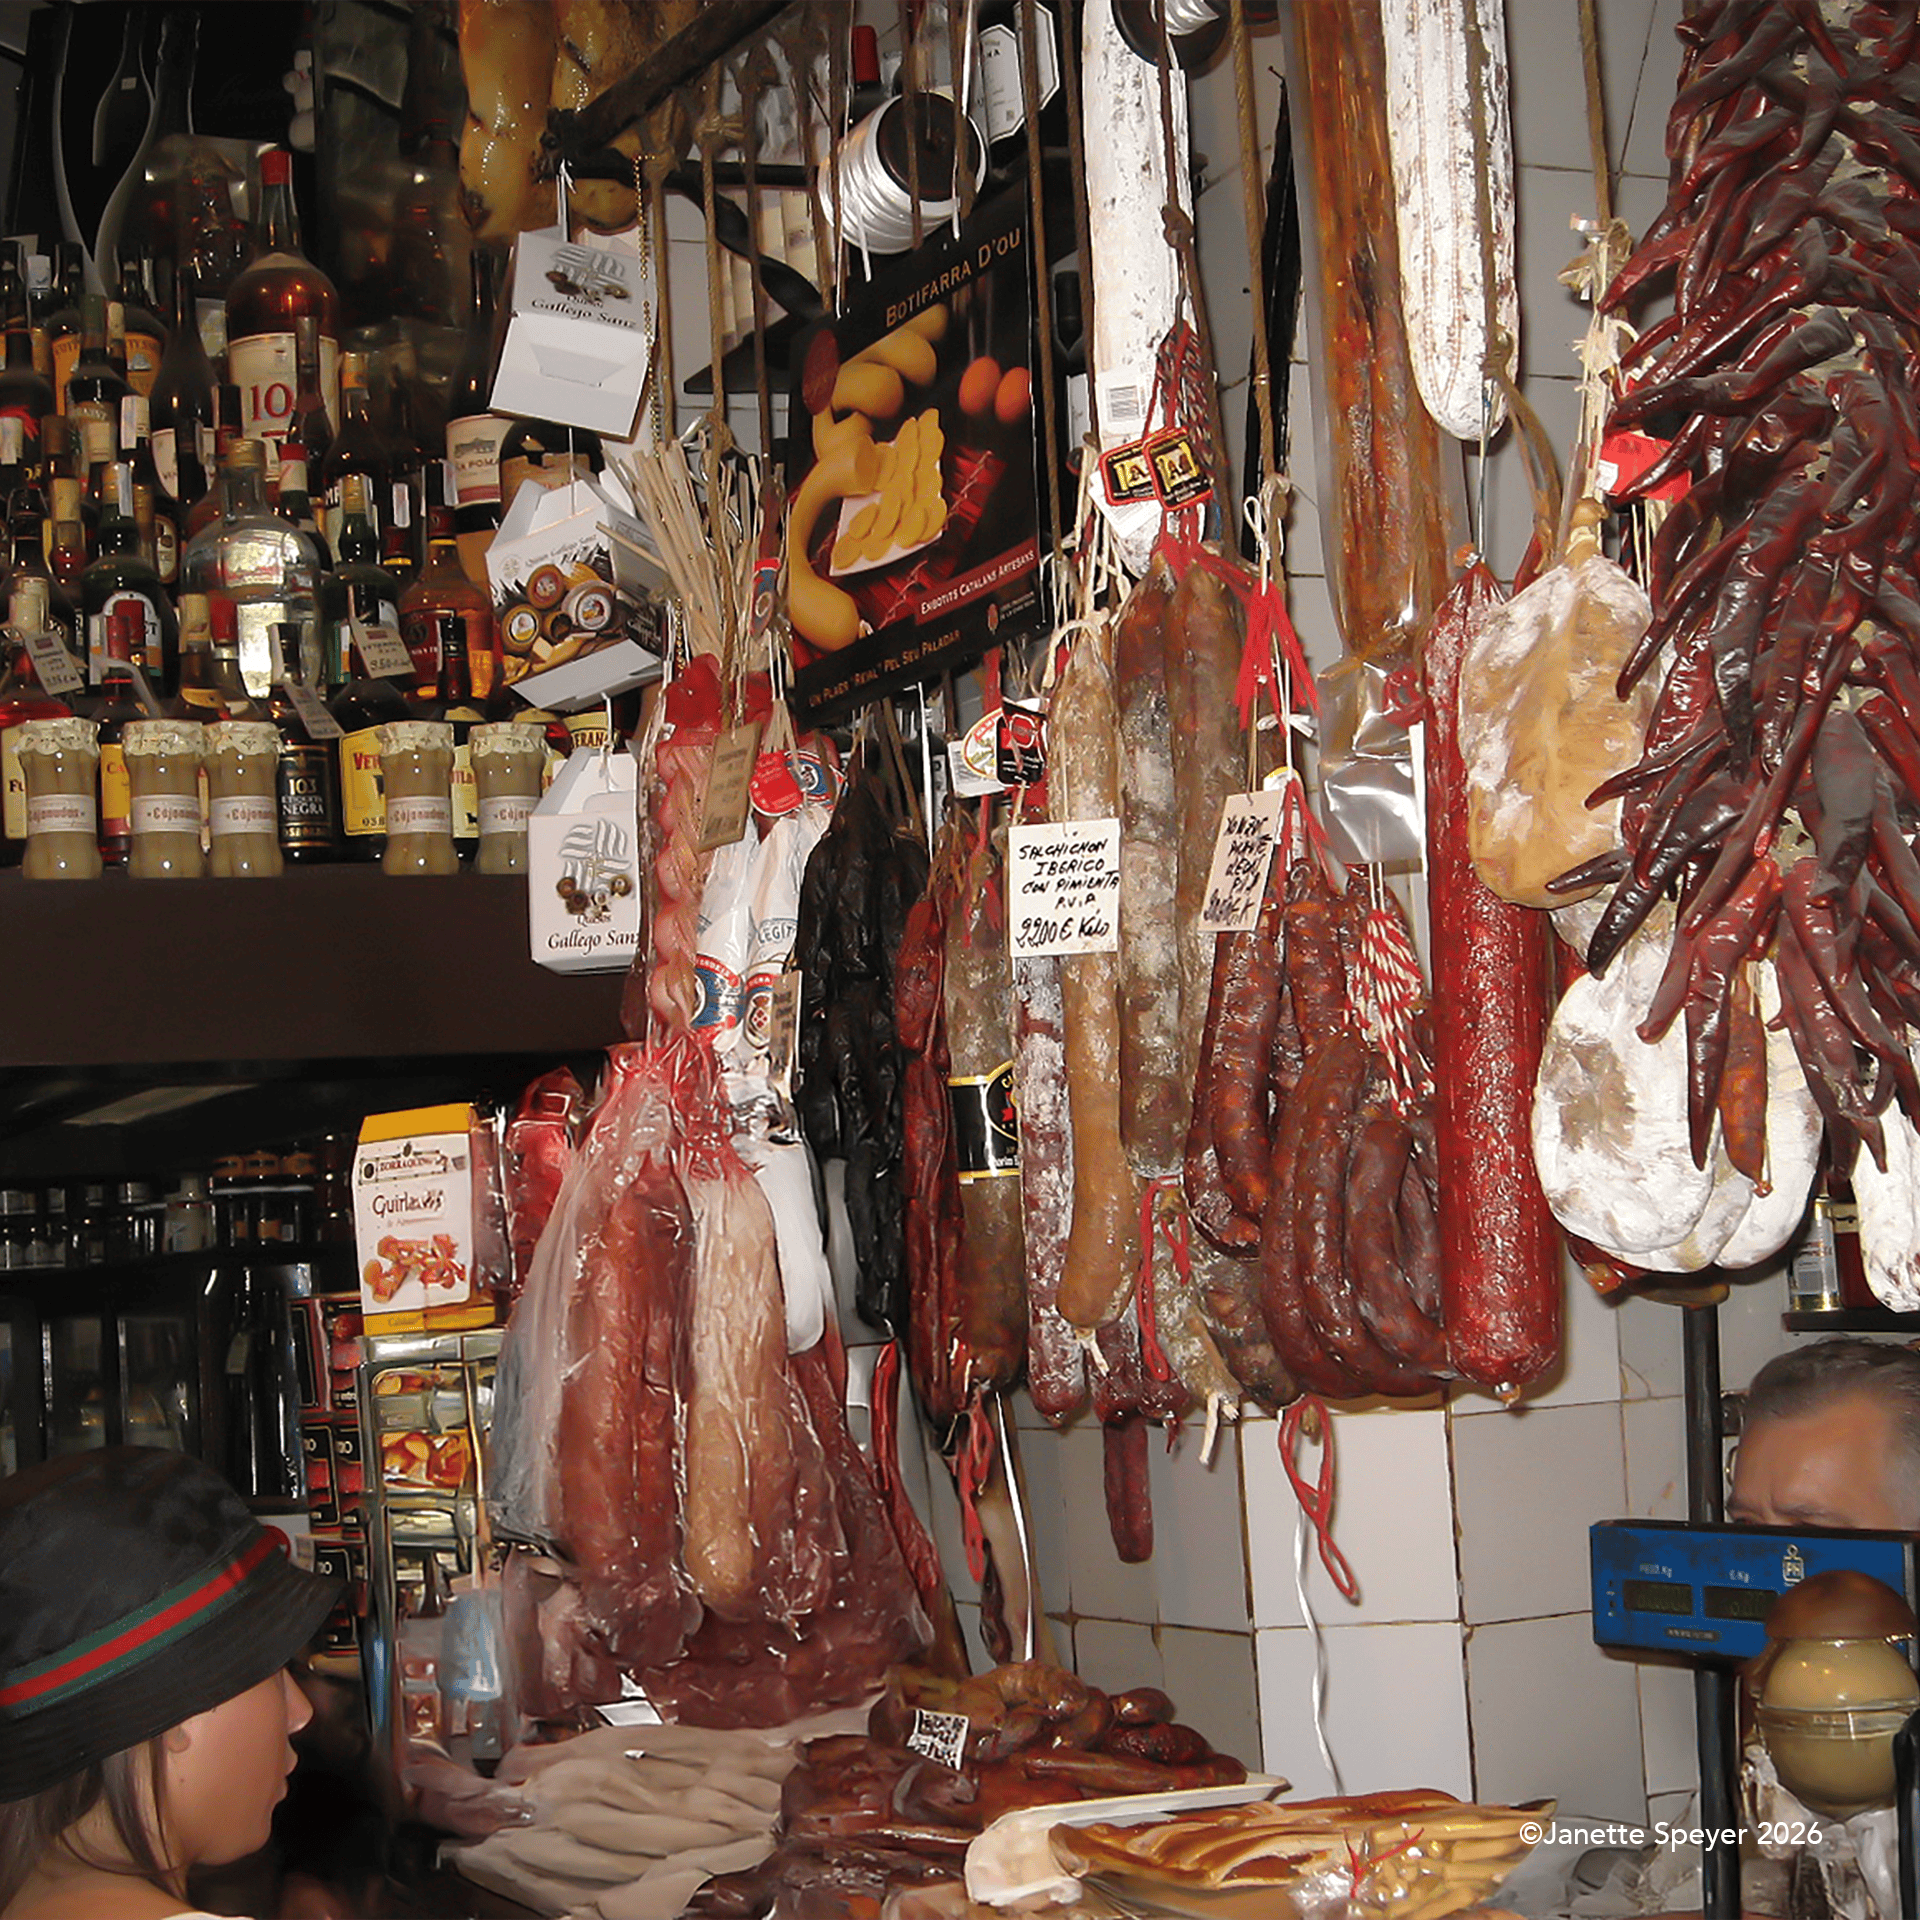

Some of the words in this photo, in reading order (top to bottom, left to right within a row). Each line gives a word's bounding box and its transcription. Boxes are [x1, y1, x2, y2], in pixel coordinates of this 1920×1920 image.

[886, 260, 971, 328] BOTIFARRA
[978, 228, 1021, 268] D'OU
[250, 382, 295, 422] 10
[959, 569, 997, 596] CATALANS
[998, 550, 1035, 578] ARTESANS
[288, 778, 317, 795] 103
[282, 803, 325, 816] NEGRA
[1033, 858, 1105, 877] IBERICO
[1021, 880, 1050, 894] CON
[548, 929, 602, 956] Gallego
